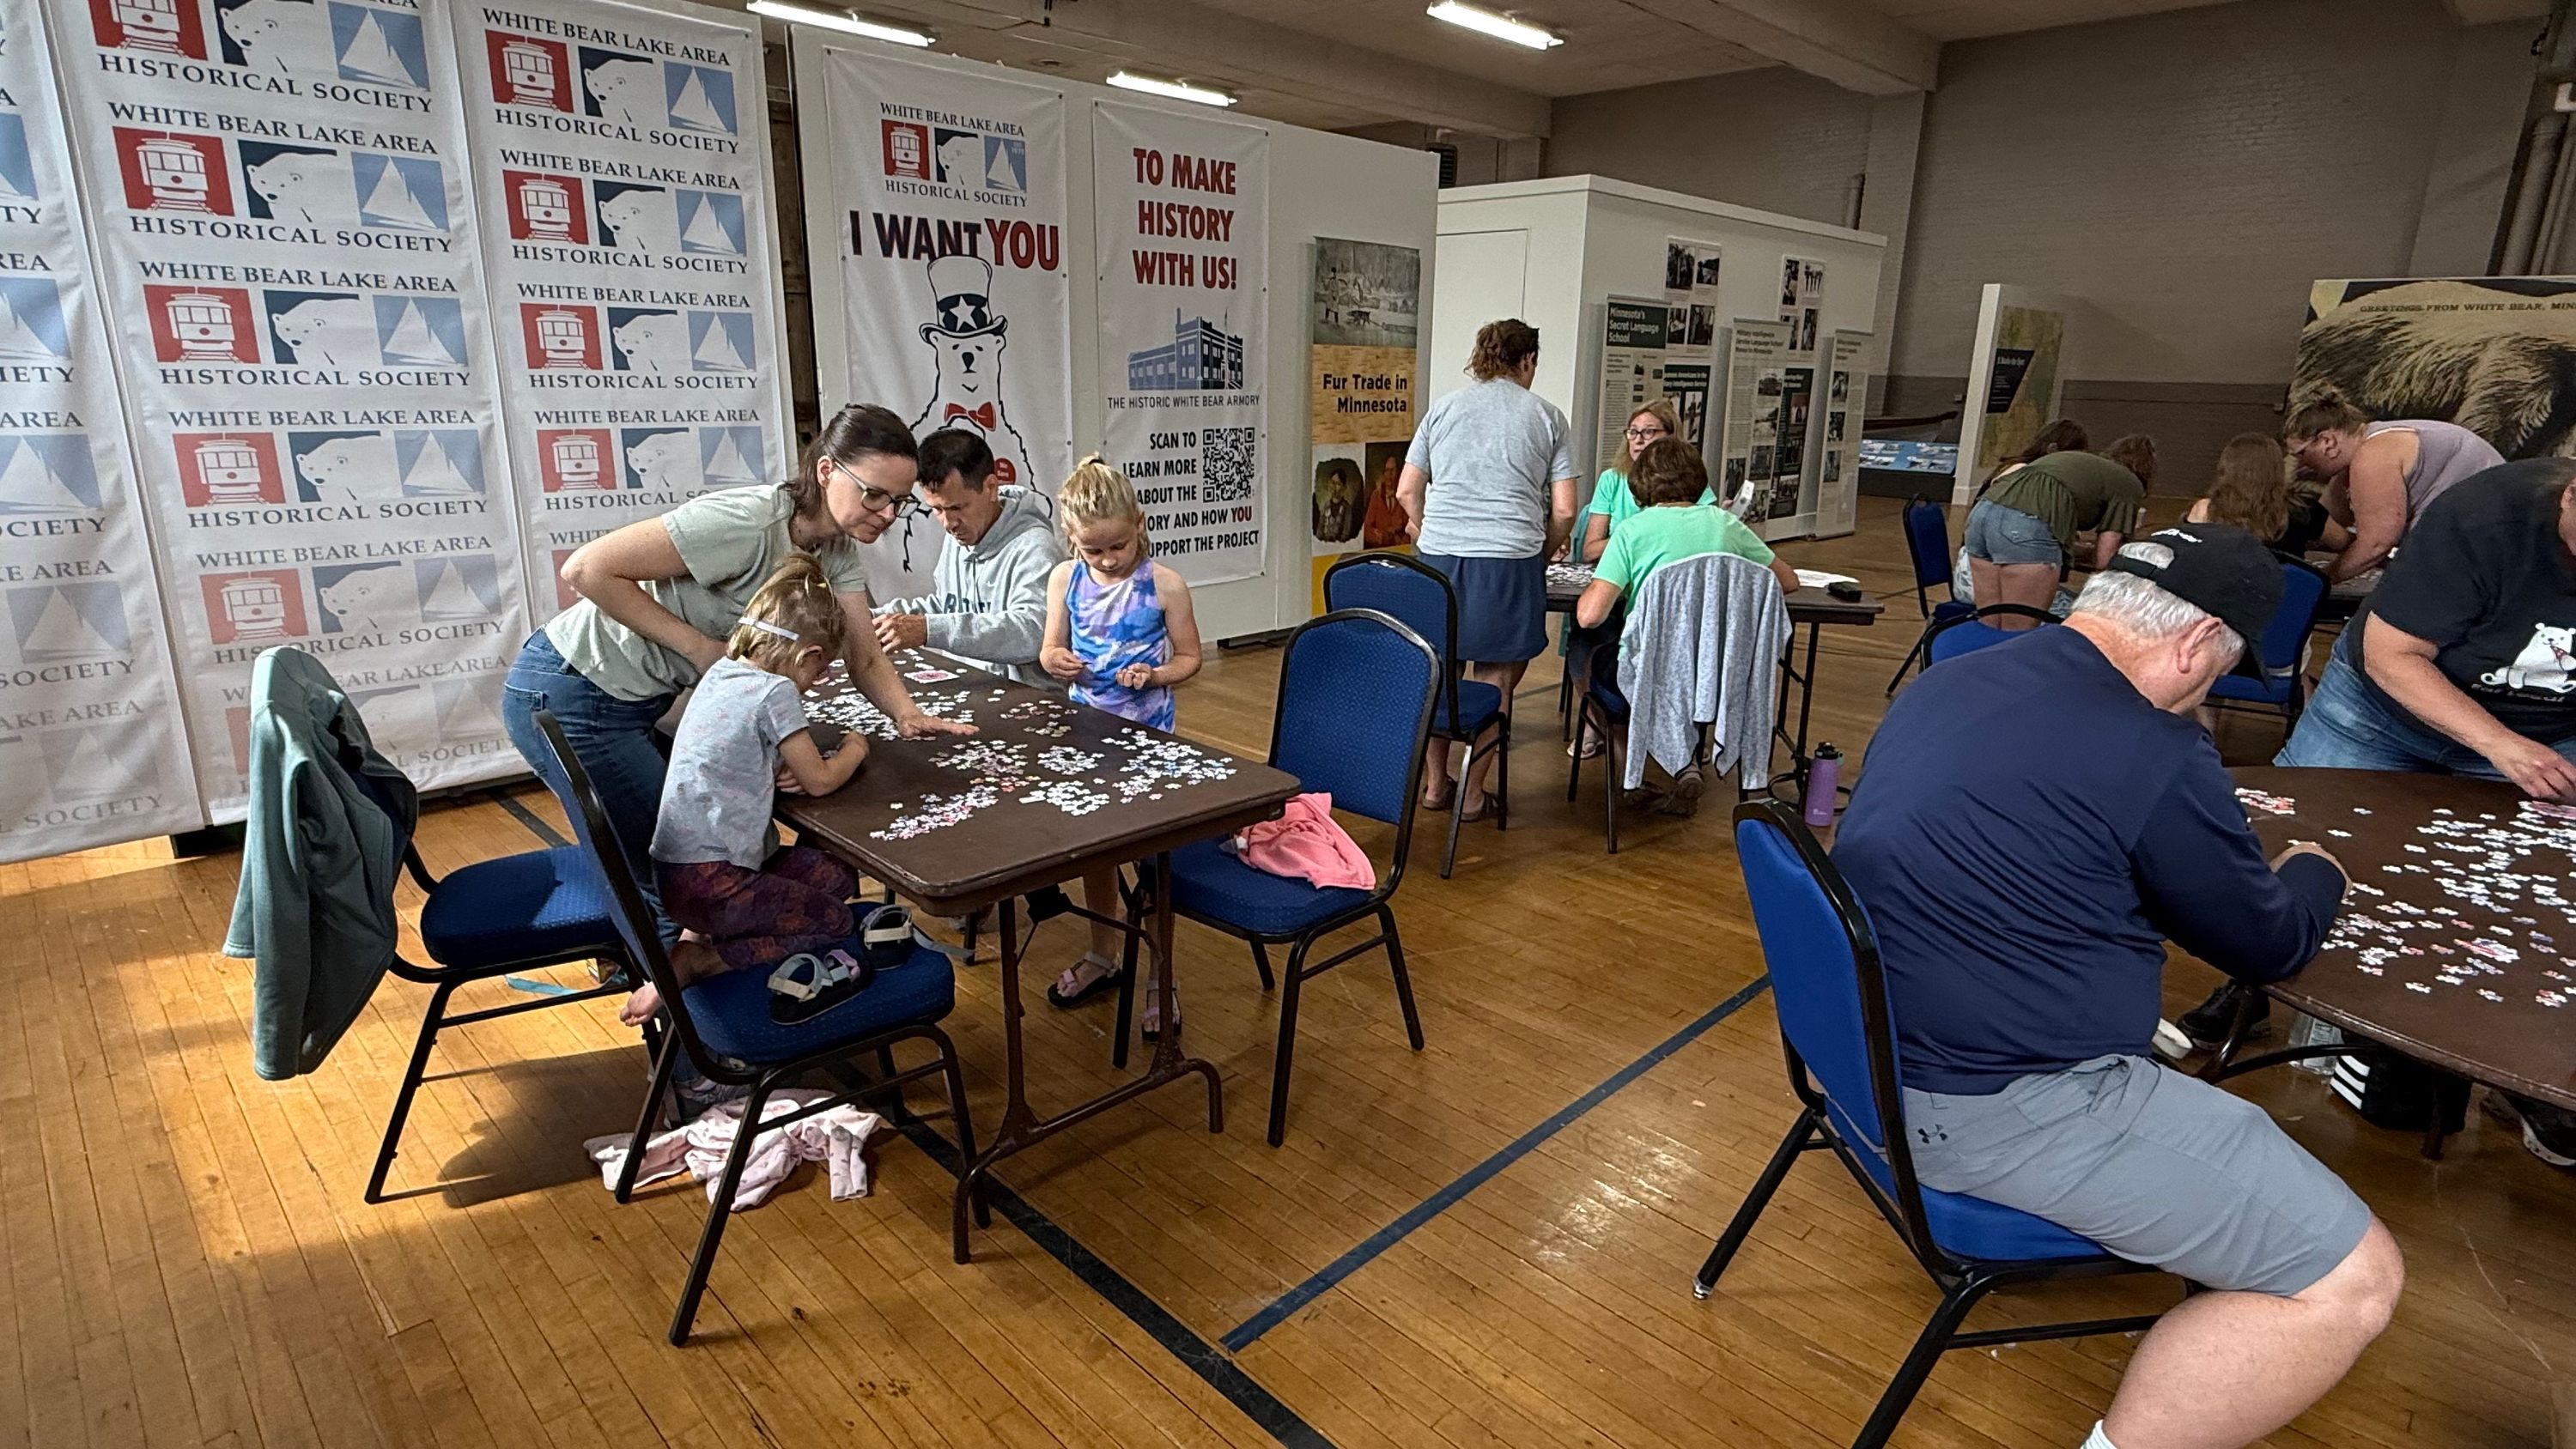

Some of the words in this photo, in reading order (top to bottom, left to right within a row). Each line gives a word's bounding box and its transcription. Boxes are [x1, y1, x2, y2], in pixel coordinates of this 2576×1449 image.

[483, 8, 557, 34] WHITE
[563, 22, 618, 46] BEAR
[623, 33, 676, 57] LAKE
[680, 45, 730, 66] AREA
[97, 53, 302, 96] HISTORICAL
[313, 82, 432, 112] SOCIETY
[106, 101, 210, 129] WHITE
[216, 114, 291, 137] BEAR
[295, 124, 366, 146] LAKE
[372, 134, 438, 155] AREA
[495, 108, 642, 142] HISTORICAL
[650, 130, 739, 154] SOCIETY
[880, 102, 923, 120] WHITE
[926, 109, 958, 126] BEAR
[961, 116, 991, 131] LAKE
[993, 121, 1024, 136] AREA
[500, 149, 574, 171] WHITE
[578, 158, 632, 178] BEAR
[637, 165, 687, 184] LAKE
[691, 173, 741, 190] AREA
[1133, 148, 1163, 186] TO
[1171, 154, 1236, 196] MAKE
[885, 179, 969, 201] HISTORICAL
[974, 191, 1027, 207] SOCIETY
[1139, 199, 1234, 242] HISTORY
[130, 216, 326, 245] HISTORICAL
[337, 230, 452, 252] SOCIETY
[849, 209, 862, 256] I
[872, 212, 981, 260] WANT
[984, 217, 1060, 271] YOU
[512, 245, 656, 268] HISTORICAL
[663, 255, 748, 274] SOCIETY
[1133, 250, 1194, 287] WITH
[1202, 256, 1236, 290] US!
[138, 261, 236, 282] WHITE
[242, 267, 314, 286] BEAR
[320, 271, 386, 288] LAKE
[393, 275, 458, 292] AREA
[517, 282, 588, 300] WHITE
[592, 288, 644, 303] BEAR
[649, 291, 699, 306] LAKE
[703, 294, 750, 308] AREA
[1608, 332, 1631, 343] School
[159, 368, 349, 385] HISTORICAL
[359, 371, 471, 386] SOCIETY
[529, 374, 667, 389] HISTORICAL
[674, 375, 758, 390] SOCIETY
[1323, 373, 1347, 390] Fur
[1352, 373, 1391, 390] Trade
[1395, 373, 1407, 390] in
[1108, 397, 1126, 409] THE
[1129, 397, 1170, 409] HISTORIC
[1173, 396, 1200, 408] WHITE
[1202, 395, 1224, 407] BEAR
[1227, 395, 1260, 406] ARMORY
[1337, 397, 1406, 413] Minnesota
[168, 411, 261, 427] WHITE
[267, 410, 337, 426] BEAR
[343, 410, 407, 424] LAKE
[413, 410, 476, 423] AREA
[534, 410, 601, 424] WHITE
[606, 409, 657, 423] BEAR
[662, 409, 708, 422] LAKE
[714, 409, 761, 421] AREA
[1150, 432, 1179, 450] SCAN
[1182, 431, 1197, 448] TO
[1123, 461, 1160, 478] LEARN
[1163, 458, 1197, 476] MORE
[545, 491, 679, 510] HISTORICAL
[1137, 487, 1174, 505] ABOUT
[1176, 485, 1197, 502] THE
[188, 506, 370, 528] HISTORICAL
[380, 500, 488, 518] SOCIETY
[1174, 512, 1198, 530] AND
[1202, 508, 1228, 525] HOW
[1231, 506, 1252, 523] YOU
[196, 549, 287, 568] WHITE
[293, 544, 359, 562] BEAR
[365, 540, 427, 557] LAKE
[433, 536, 493, 552] AREA
[1194, 536, 1214, 552] THE
[1217, 530, 1259, 549] PROJECT
[33, 561, 115, 580] AREA
[399, 621, 503, 644] SOCIETY
[386, 663, 443, 682] LAKE
[447, 656, 507, 676] AREA
[65, 700, 144, 722] AREA
[24, 793, 162, 829] SOCIETY
